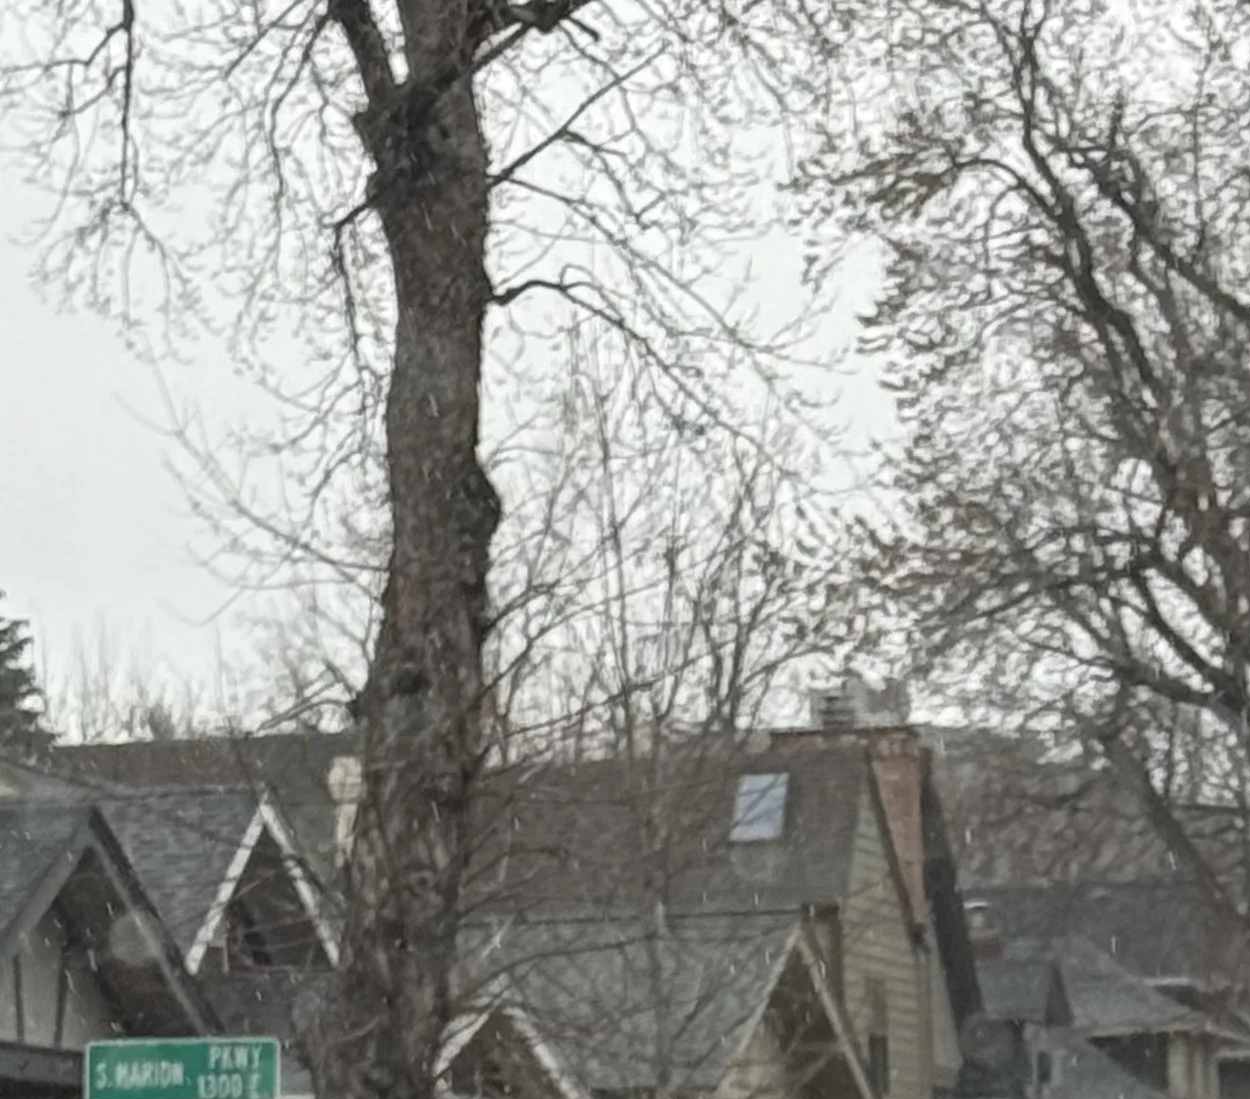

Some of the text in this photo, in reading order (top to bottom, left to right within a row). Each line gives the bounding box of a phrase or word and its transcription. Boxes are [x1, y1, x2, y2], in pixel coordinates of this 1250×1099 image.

[208, 1045, 263, 1070] PKWY
[115, 1060, 185, 1089] MARION
[197, 1073, 243, 1099] 1300
